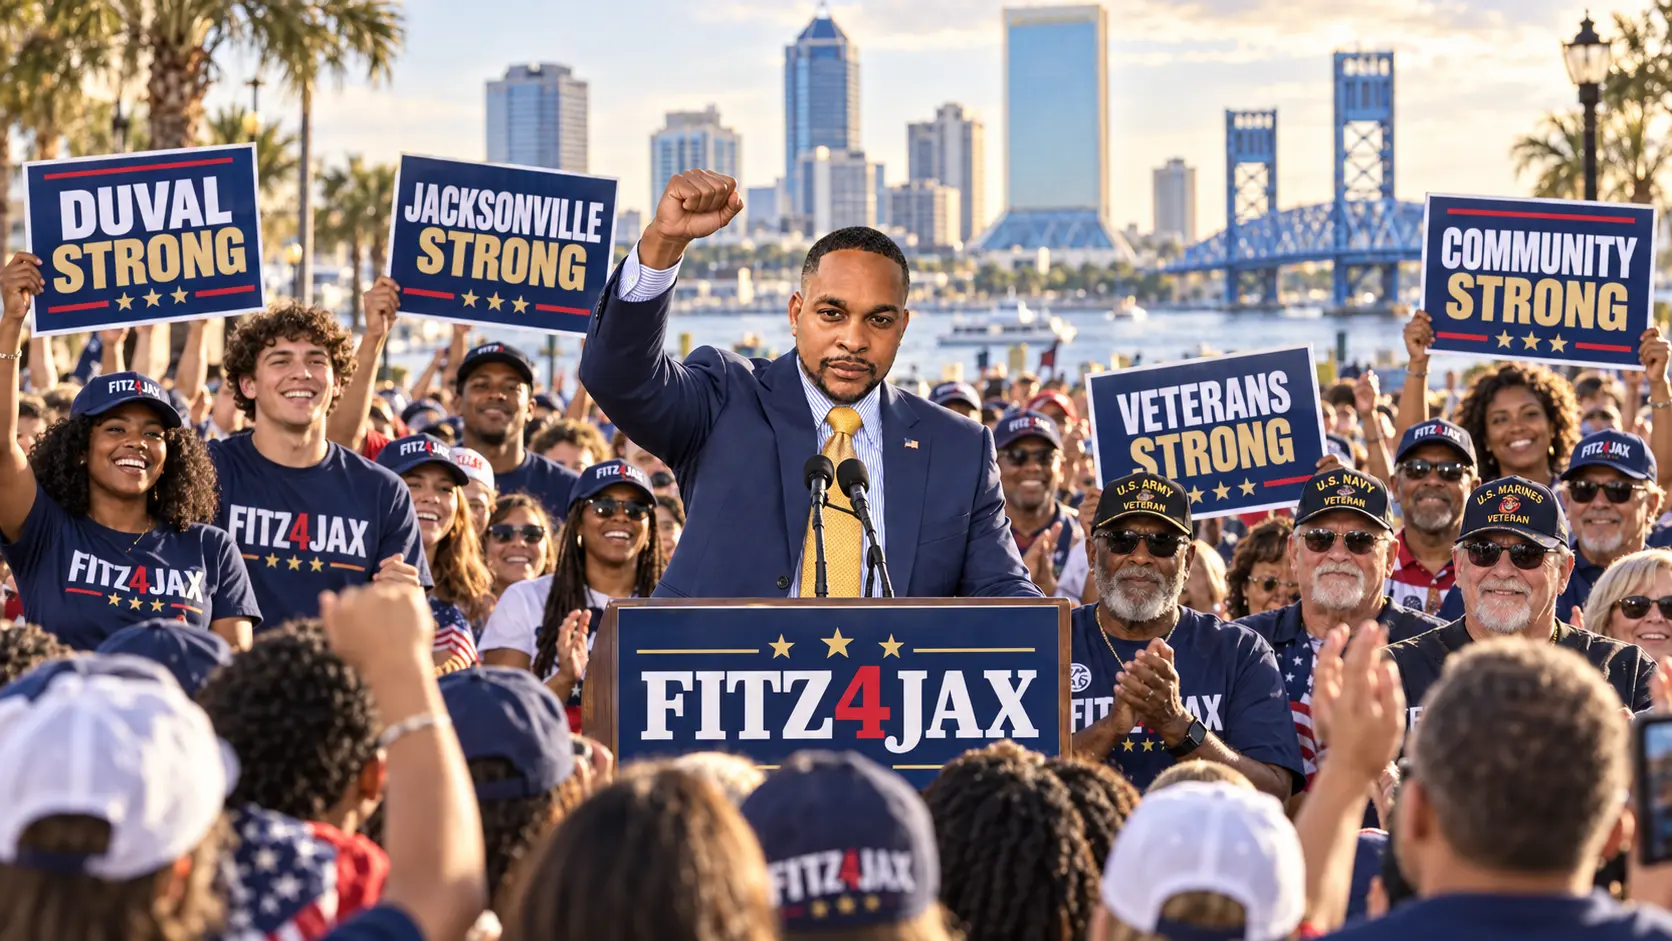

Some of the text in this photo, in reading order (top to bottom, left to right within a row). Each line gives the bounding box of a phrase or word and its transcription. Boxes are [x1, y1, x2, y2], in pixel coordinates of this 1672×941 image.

[60, 175, 233, 242] DUVAL
[404, 182, 604, 244] JACKSONVILLE
[51, 225, 248, 294] STRONG
[415, 226, 588, 292] STRONG
[1441, 226, 1638, 279] COMMUNITY
[1445, 272, 1629, 332] STRONG
[108, 376, 162, 400] FITZ4JAX
[1116, 369, 1292, 436] VETERANS
[399, 440, 451, 460] FITZ4JAX
[1129, 417, 1296, 480] STRONG
[1414, 424, 1461, 443] FITZ4JAX
[1581, 440, 1631, 460] FITZ4JAX
[596, 463, 644, 483] FITZ4JAX
[1116, 479, 1175, 498] U.S. ARMY
[1316, 475, 1376, 494] U.S. NAVY
[1476, 485, 1545, 506] U.S. MARINES
[1123, 500, 1167, 514] VETERAN
[1323, 496, 1366, 509] VETERAN
[1487, 514, 1530, 525] VETERAN
[229, 504, 370, 559] FITZ4JAX
[67, 549, 205, 605] FITZ4JAX
[640, 665, 1040, 754] FITZ4JAX
[1071, 694, 1224, 734] FITAX
[768, 847, 916, 903] FITZ4JAX
